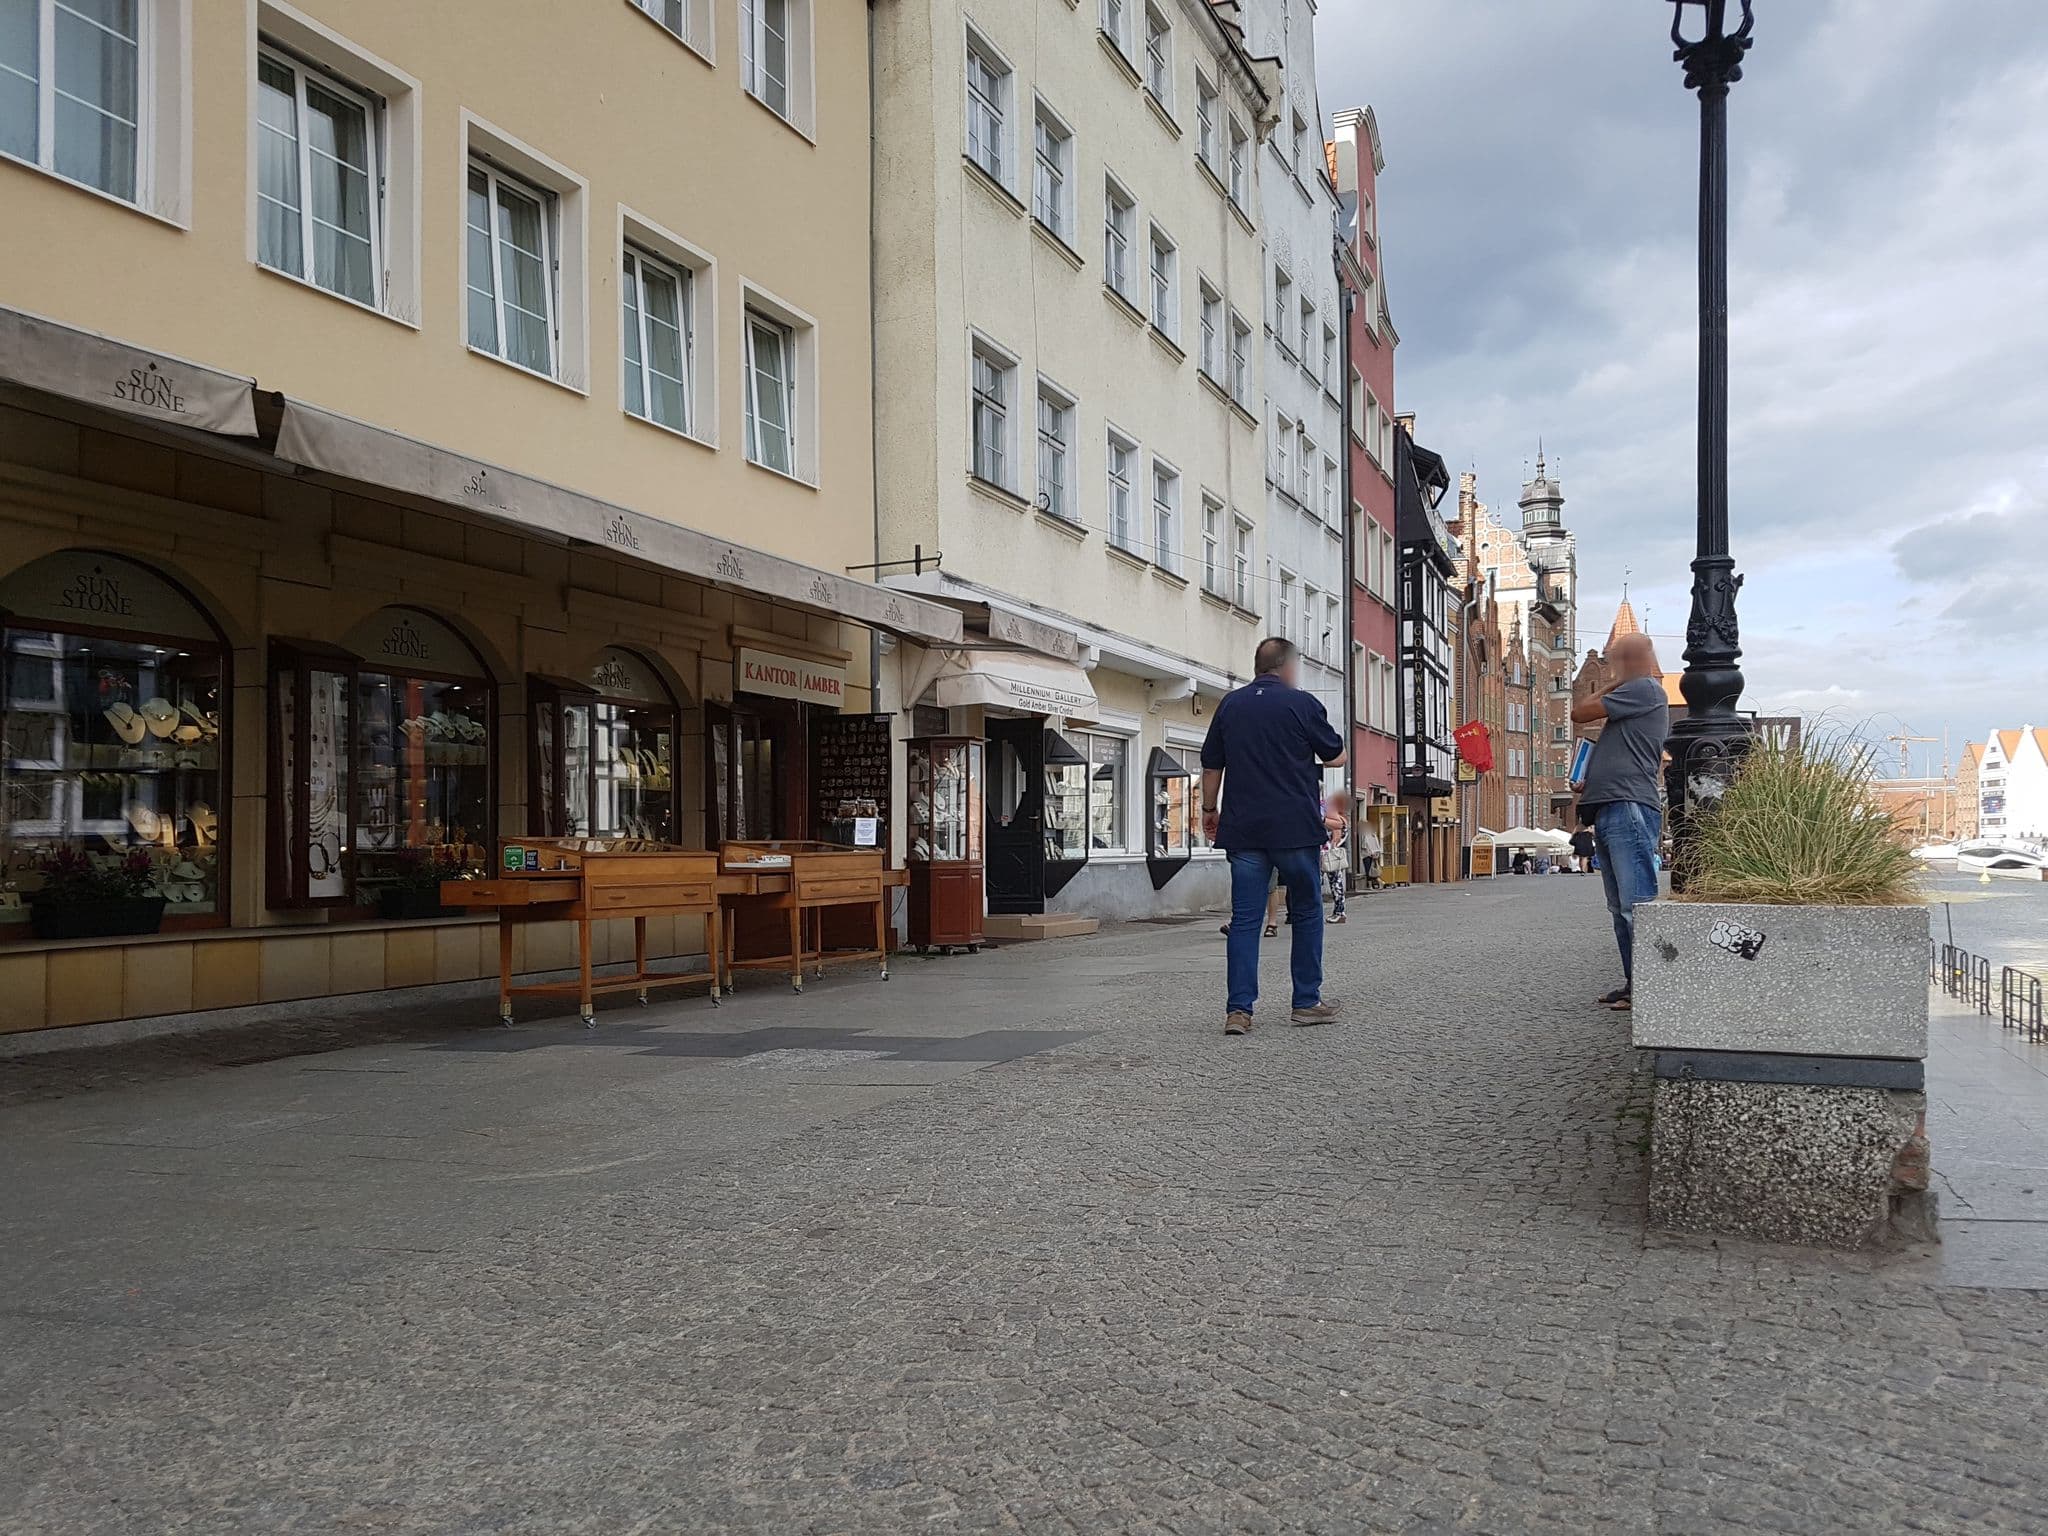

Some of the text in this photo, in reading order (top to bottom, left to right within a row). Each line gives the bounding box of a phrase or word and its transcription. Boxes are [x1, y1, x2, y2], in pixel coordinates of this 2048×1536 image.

[130, 368, 173, 396] SUN
[114, 380, 185, 413] STONE
[606, 528, 640, 550] STONE
[611, 520, 632, 539] SUN
[717, 562, 744, 580] STONE
[721, 554, 740, 570] SUN
[76, 574, 120, 595] SUN
[63, 589, 134, 616] STONE
[391, 626, 420, 643] SUN
[382, 638, 430, 659] STONE
[603, 663, 624, 677] SUN
[745, 662, 841, 695] KANTOR AMBER
[597, 672, 631, 690] STONE
[1413, 625, 1424, 744] GOLDWASSER
[1010, 682, 1082, 705] MILLENNIUM GALLERY
[1018, 698, 1031, 709] Gold
